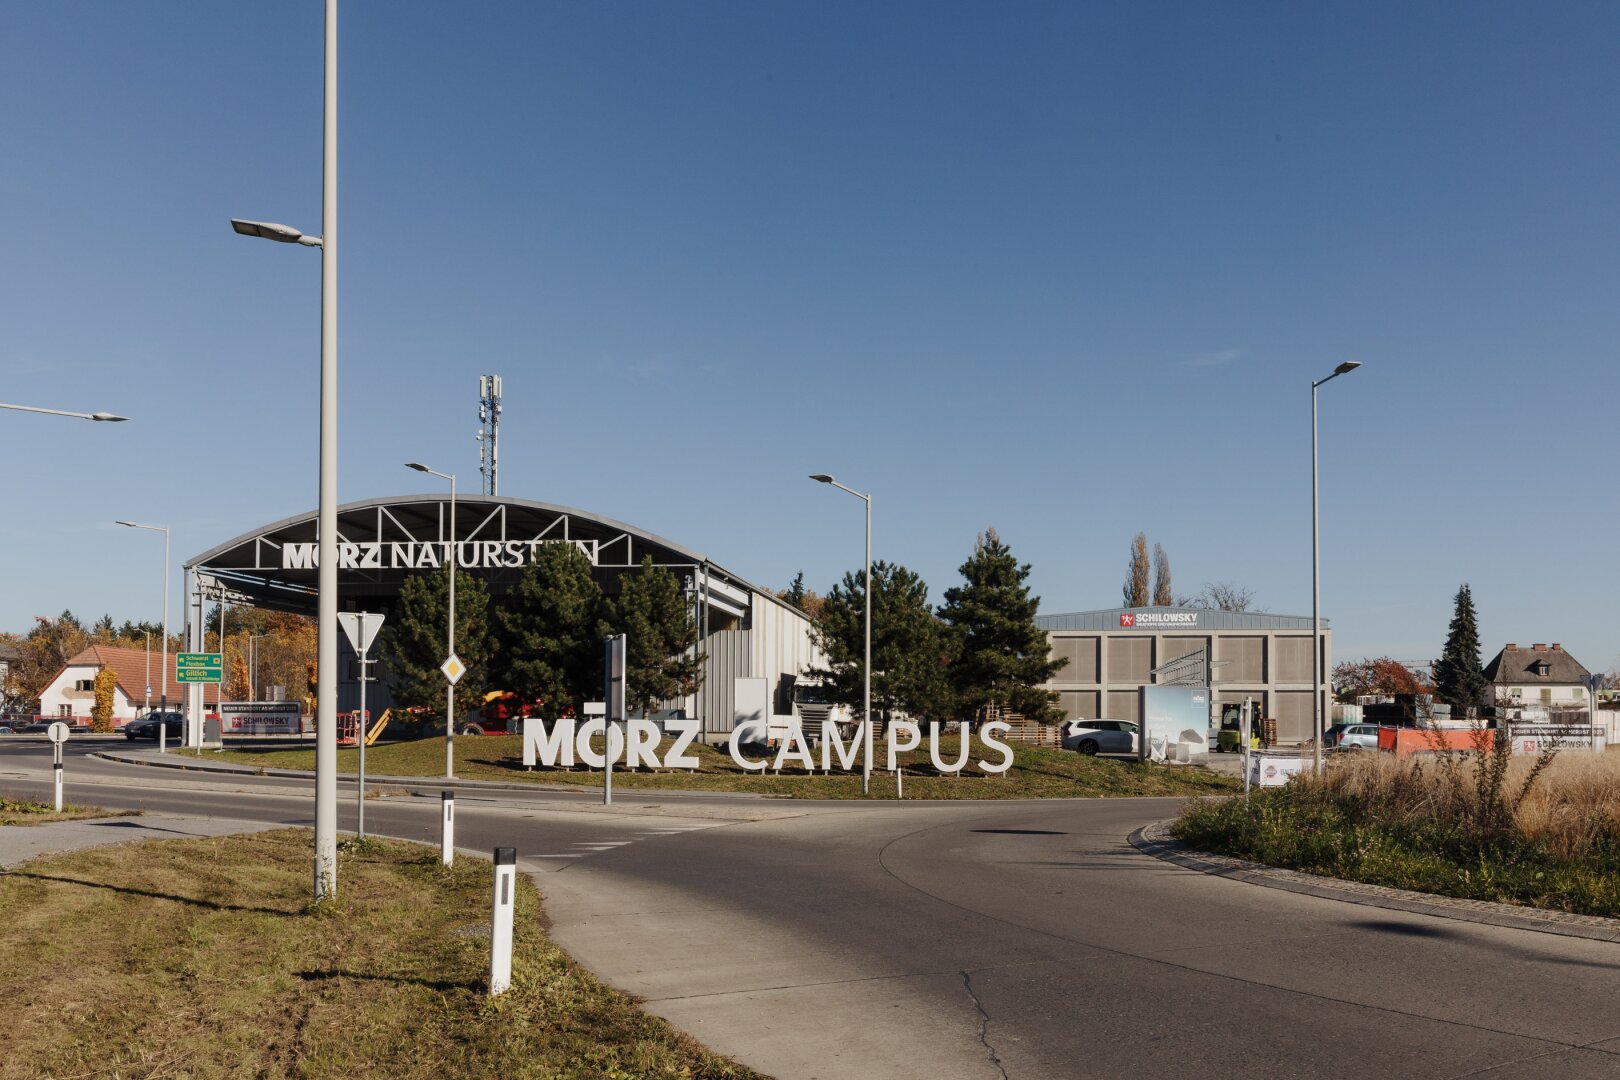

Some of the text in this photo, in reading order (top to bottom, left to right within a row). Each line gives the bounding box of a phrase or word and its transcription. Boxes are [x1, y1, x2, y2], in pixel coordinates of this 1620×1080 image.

[283, 540, 599, 569] MRZ NATURSTN
[1135, 613, 1198, 622] SCHILOWSKY
[243, 717, 290, 725] SCHILOWSKY
[728, 720, 1014, 773] CAMPUS
